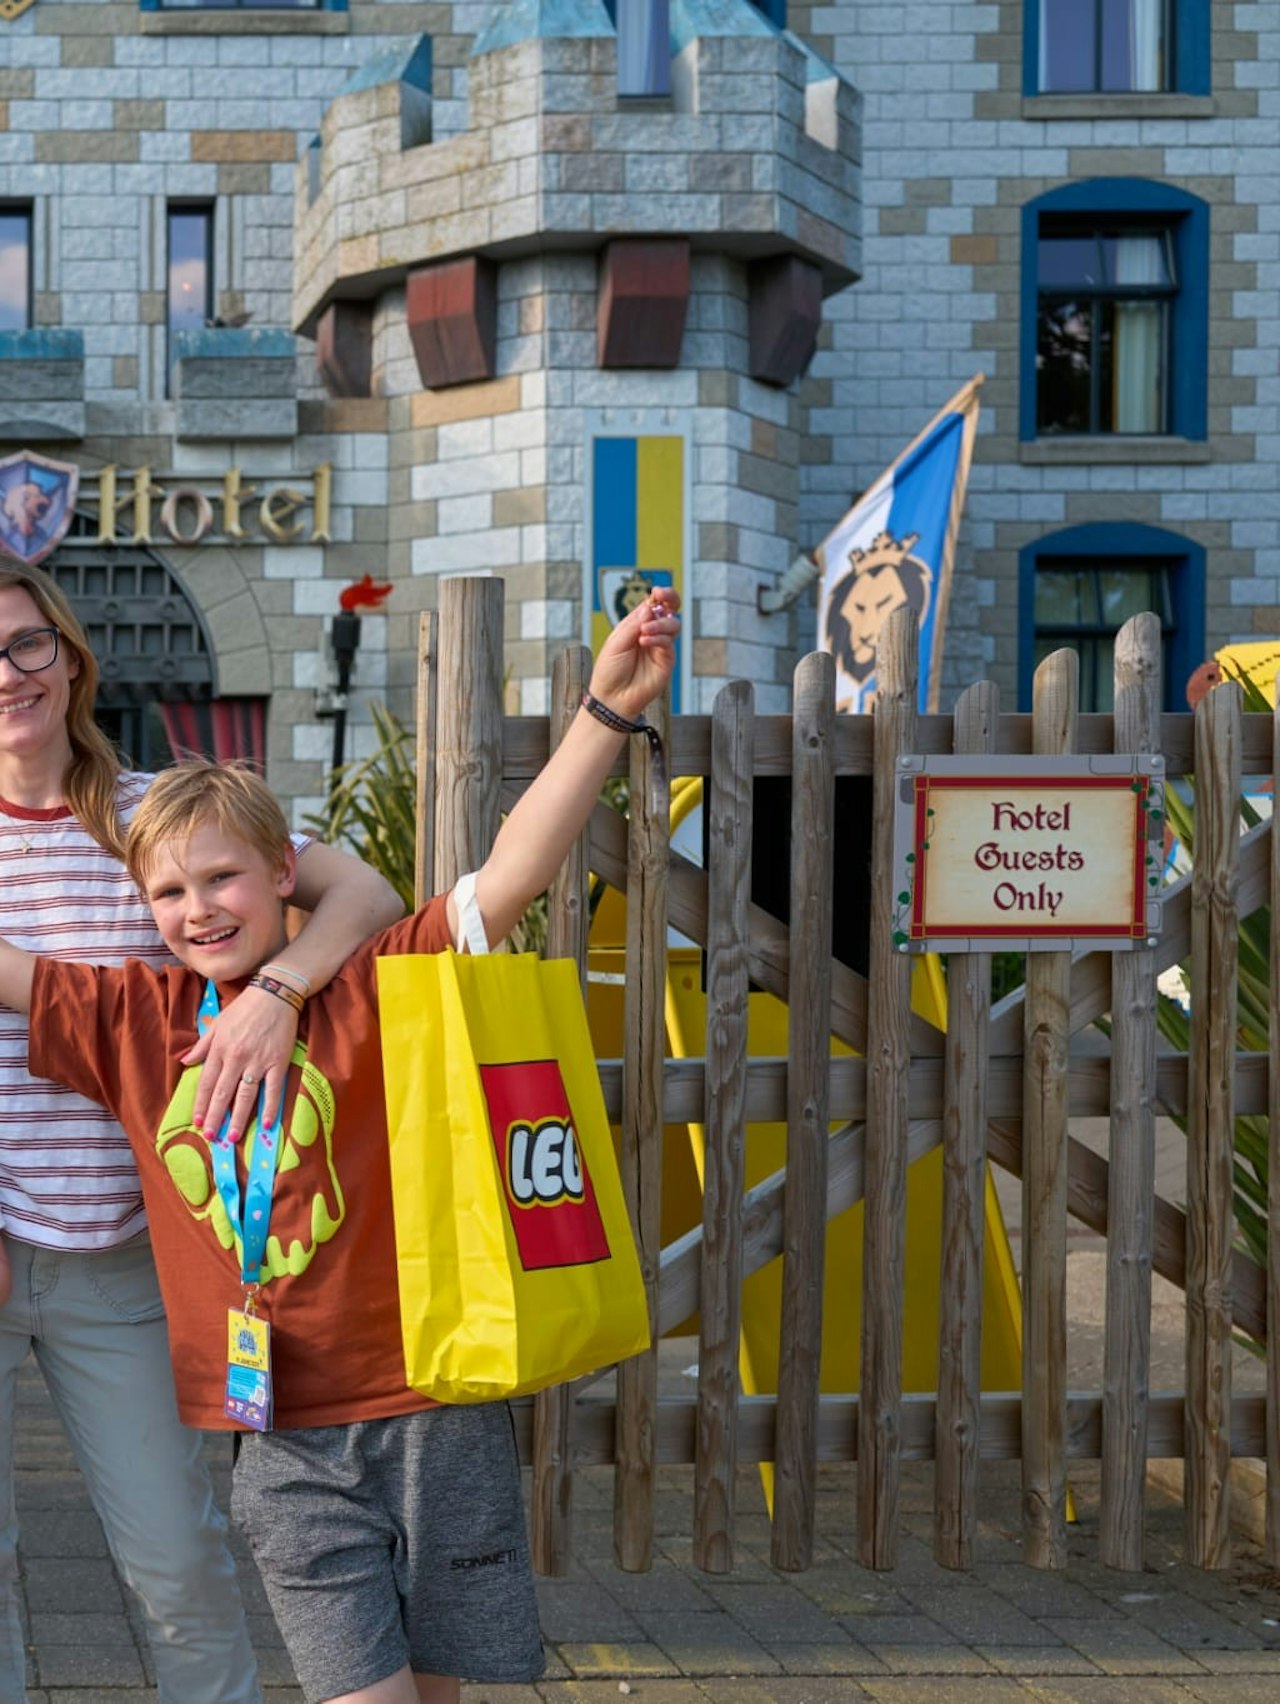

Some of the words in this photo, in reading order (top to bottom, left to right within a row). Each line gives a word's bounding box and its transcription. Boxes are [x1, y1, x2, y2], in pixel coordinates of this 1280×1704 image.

[98, 464, 332, 545] Hotel
[991, 801, 1071, 831] Hotel
[974, 842, 1085, 871] Guests
[993, 881, 1063, 917] Only
